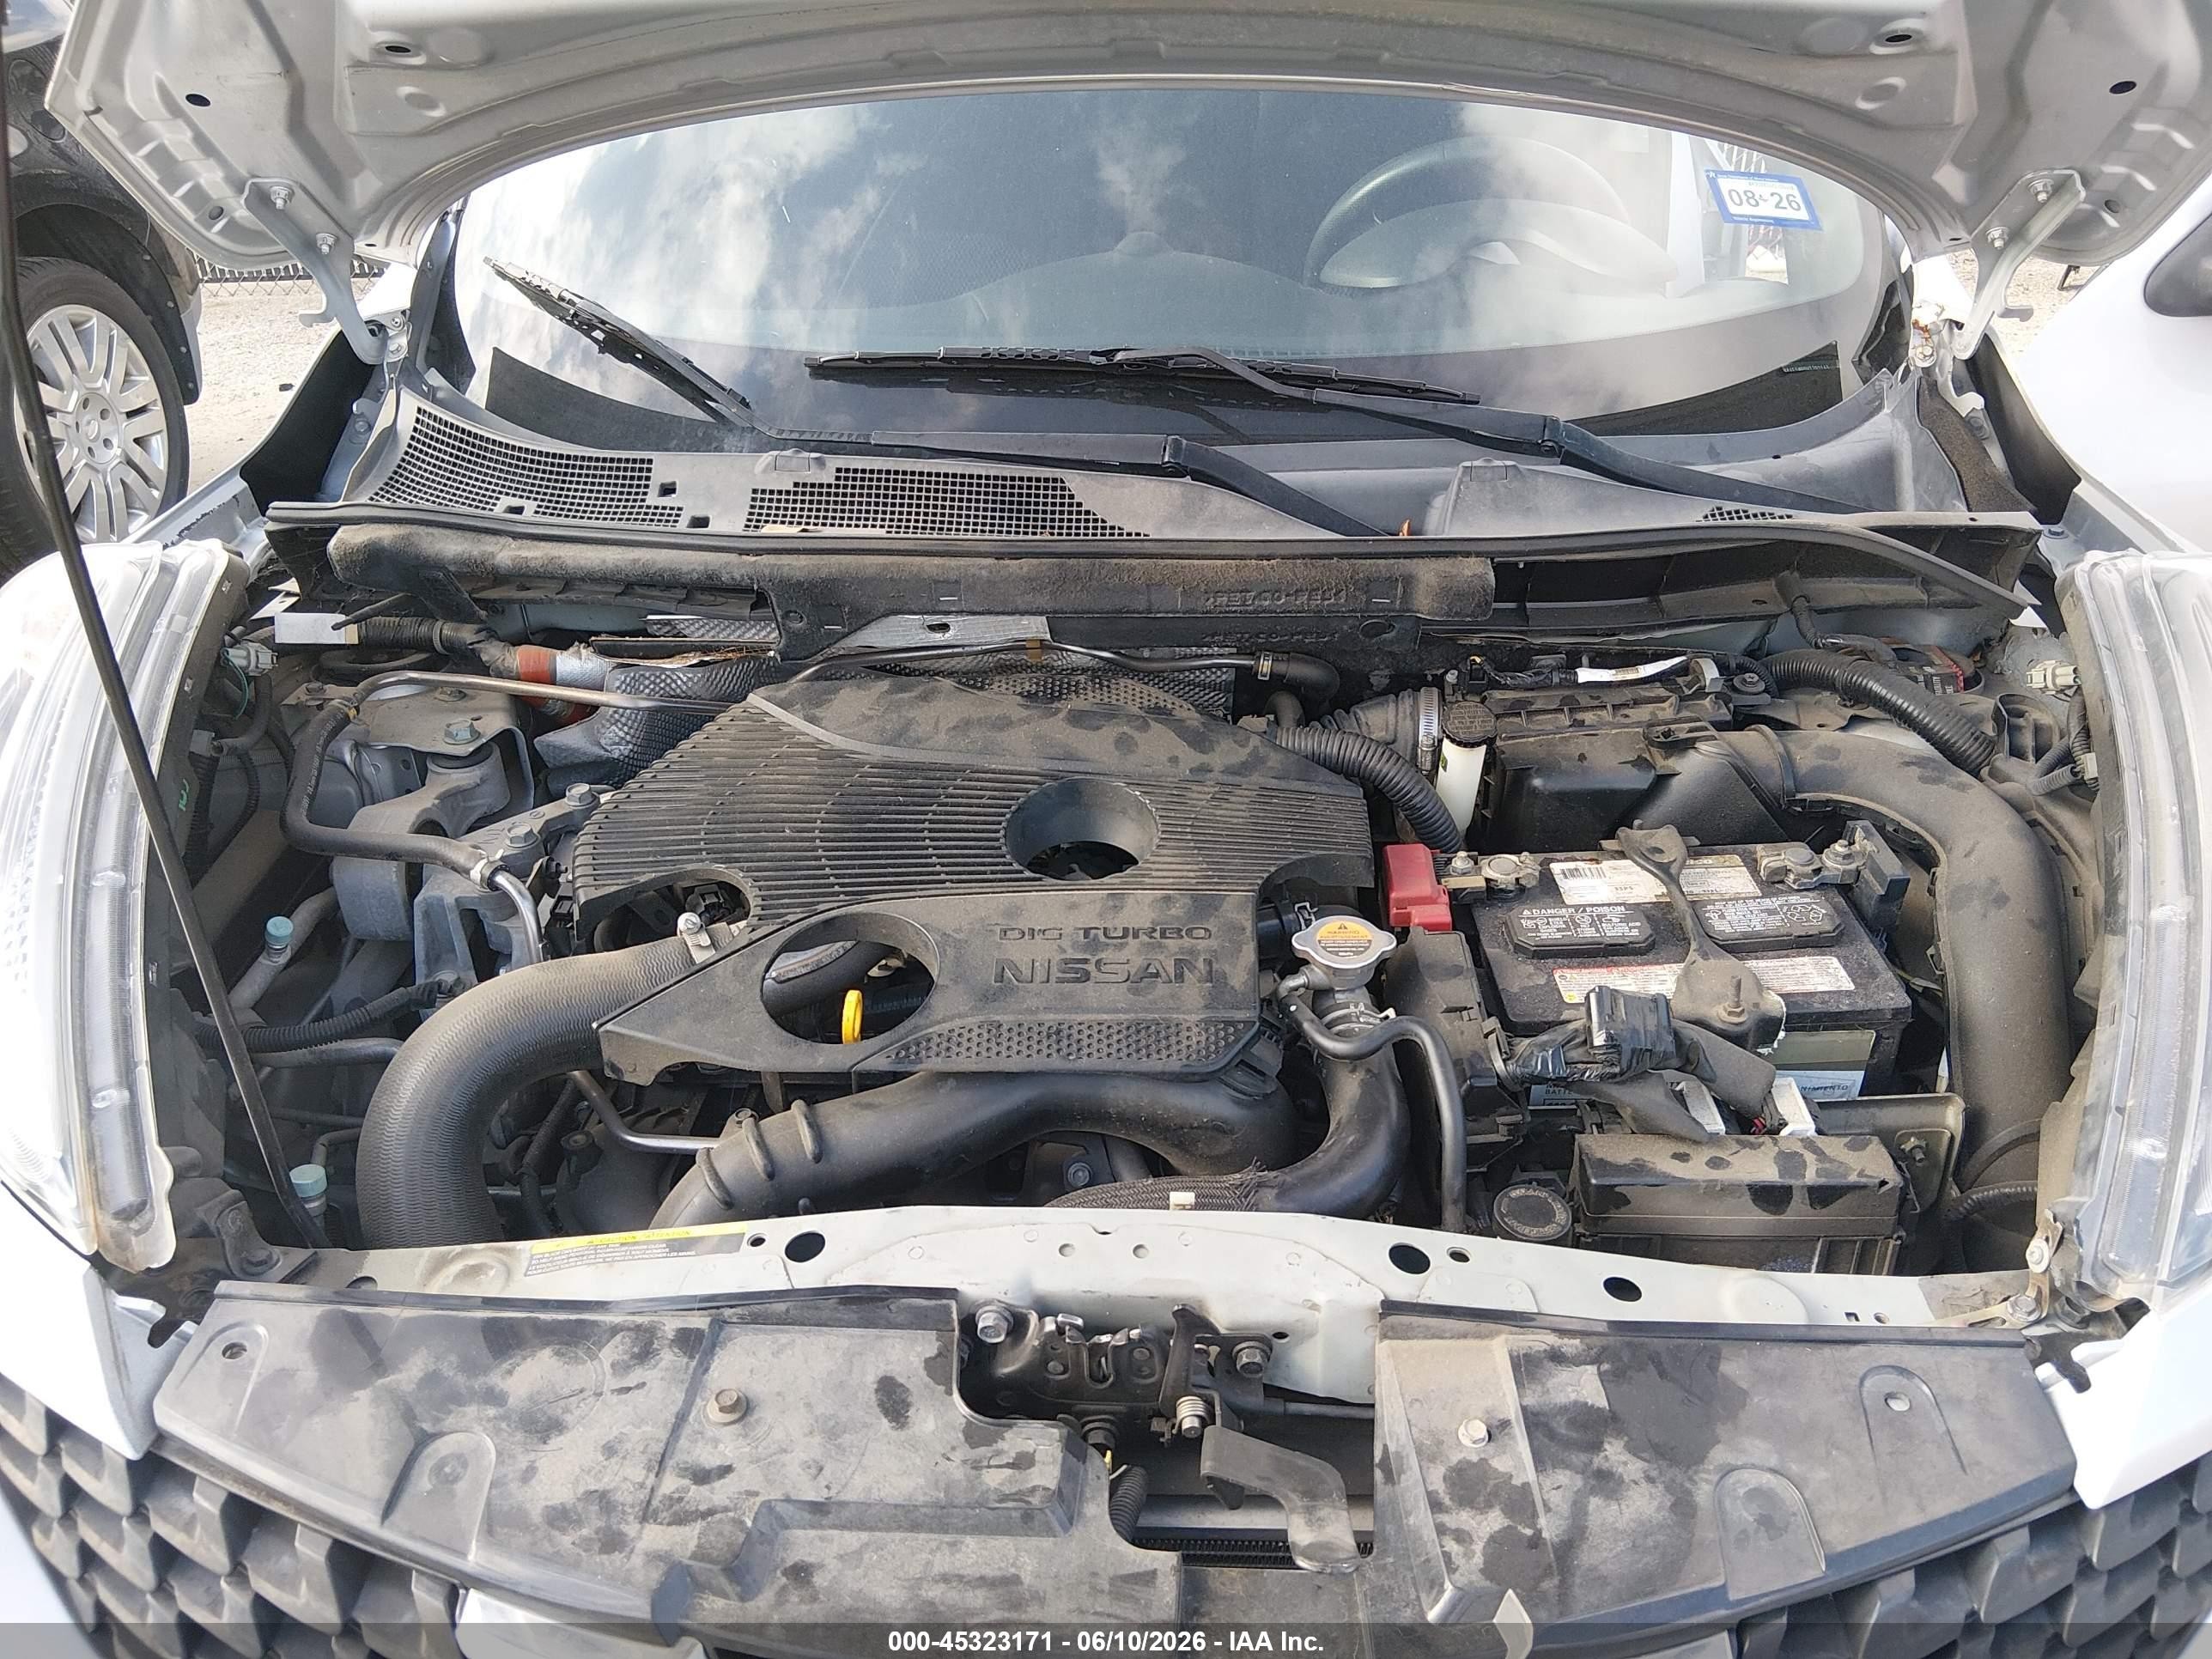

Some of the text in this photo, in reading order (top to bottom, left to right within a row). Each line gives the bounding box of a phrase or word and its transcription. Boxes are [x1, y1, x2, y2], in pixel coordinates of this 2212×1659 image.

[1586, 905, 1626, 914] POISON
[999, 926, 1212, 941] DIG TURBO
[994, 957, 1213, 984] NISSAN
